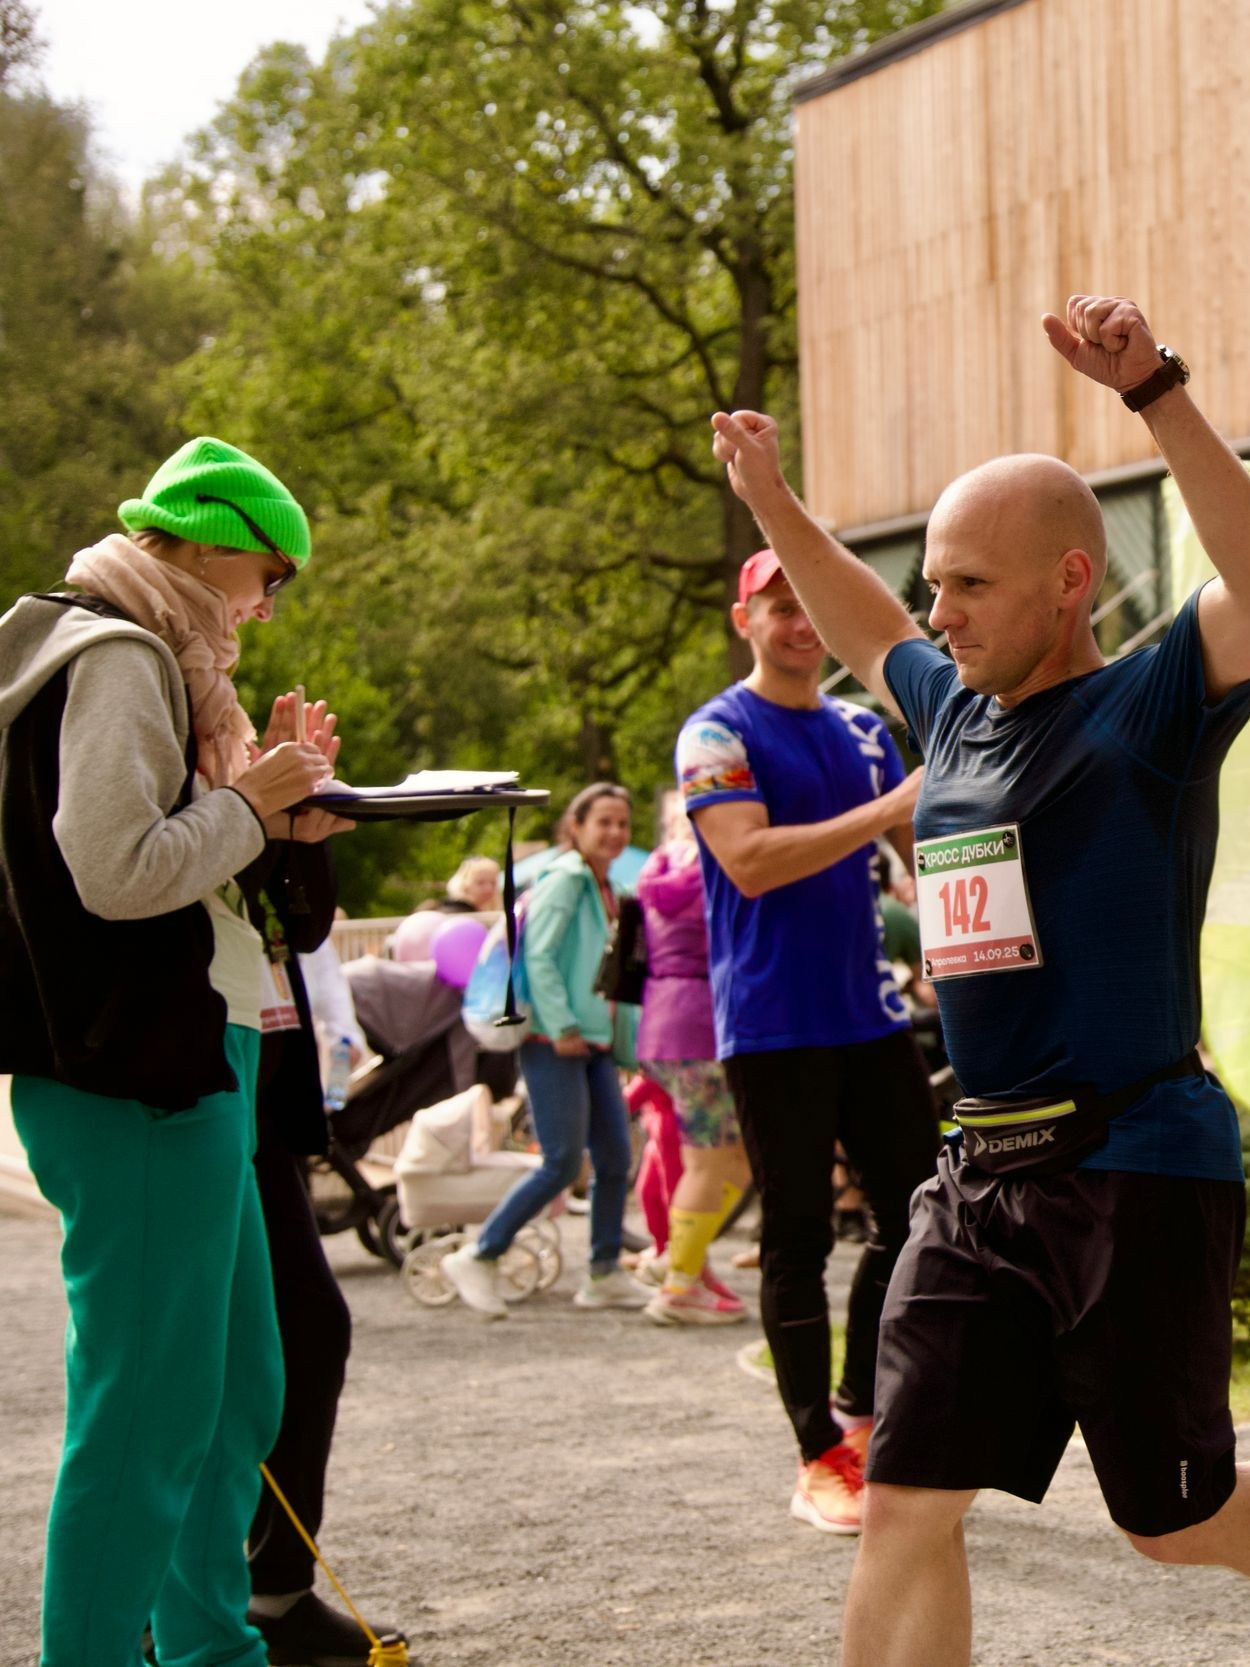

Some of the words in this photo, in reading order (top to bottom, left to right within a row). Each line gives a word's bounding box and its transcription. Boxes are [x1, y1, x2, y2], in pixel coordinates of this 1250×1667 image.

[924, 848, 960, 868] КРОСС
[961, 840, 1005, 865] ДУБКИ
[938, 875, 991, 936] 142
[974, 946, 1020, 963] 14.09.25
[988, 1125, 1056, 1154] DEMIX
